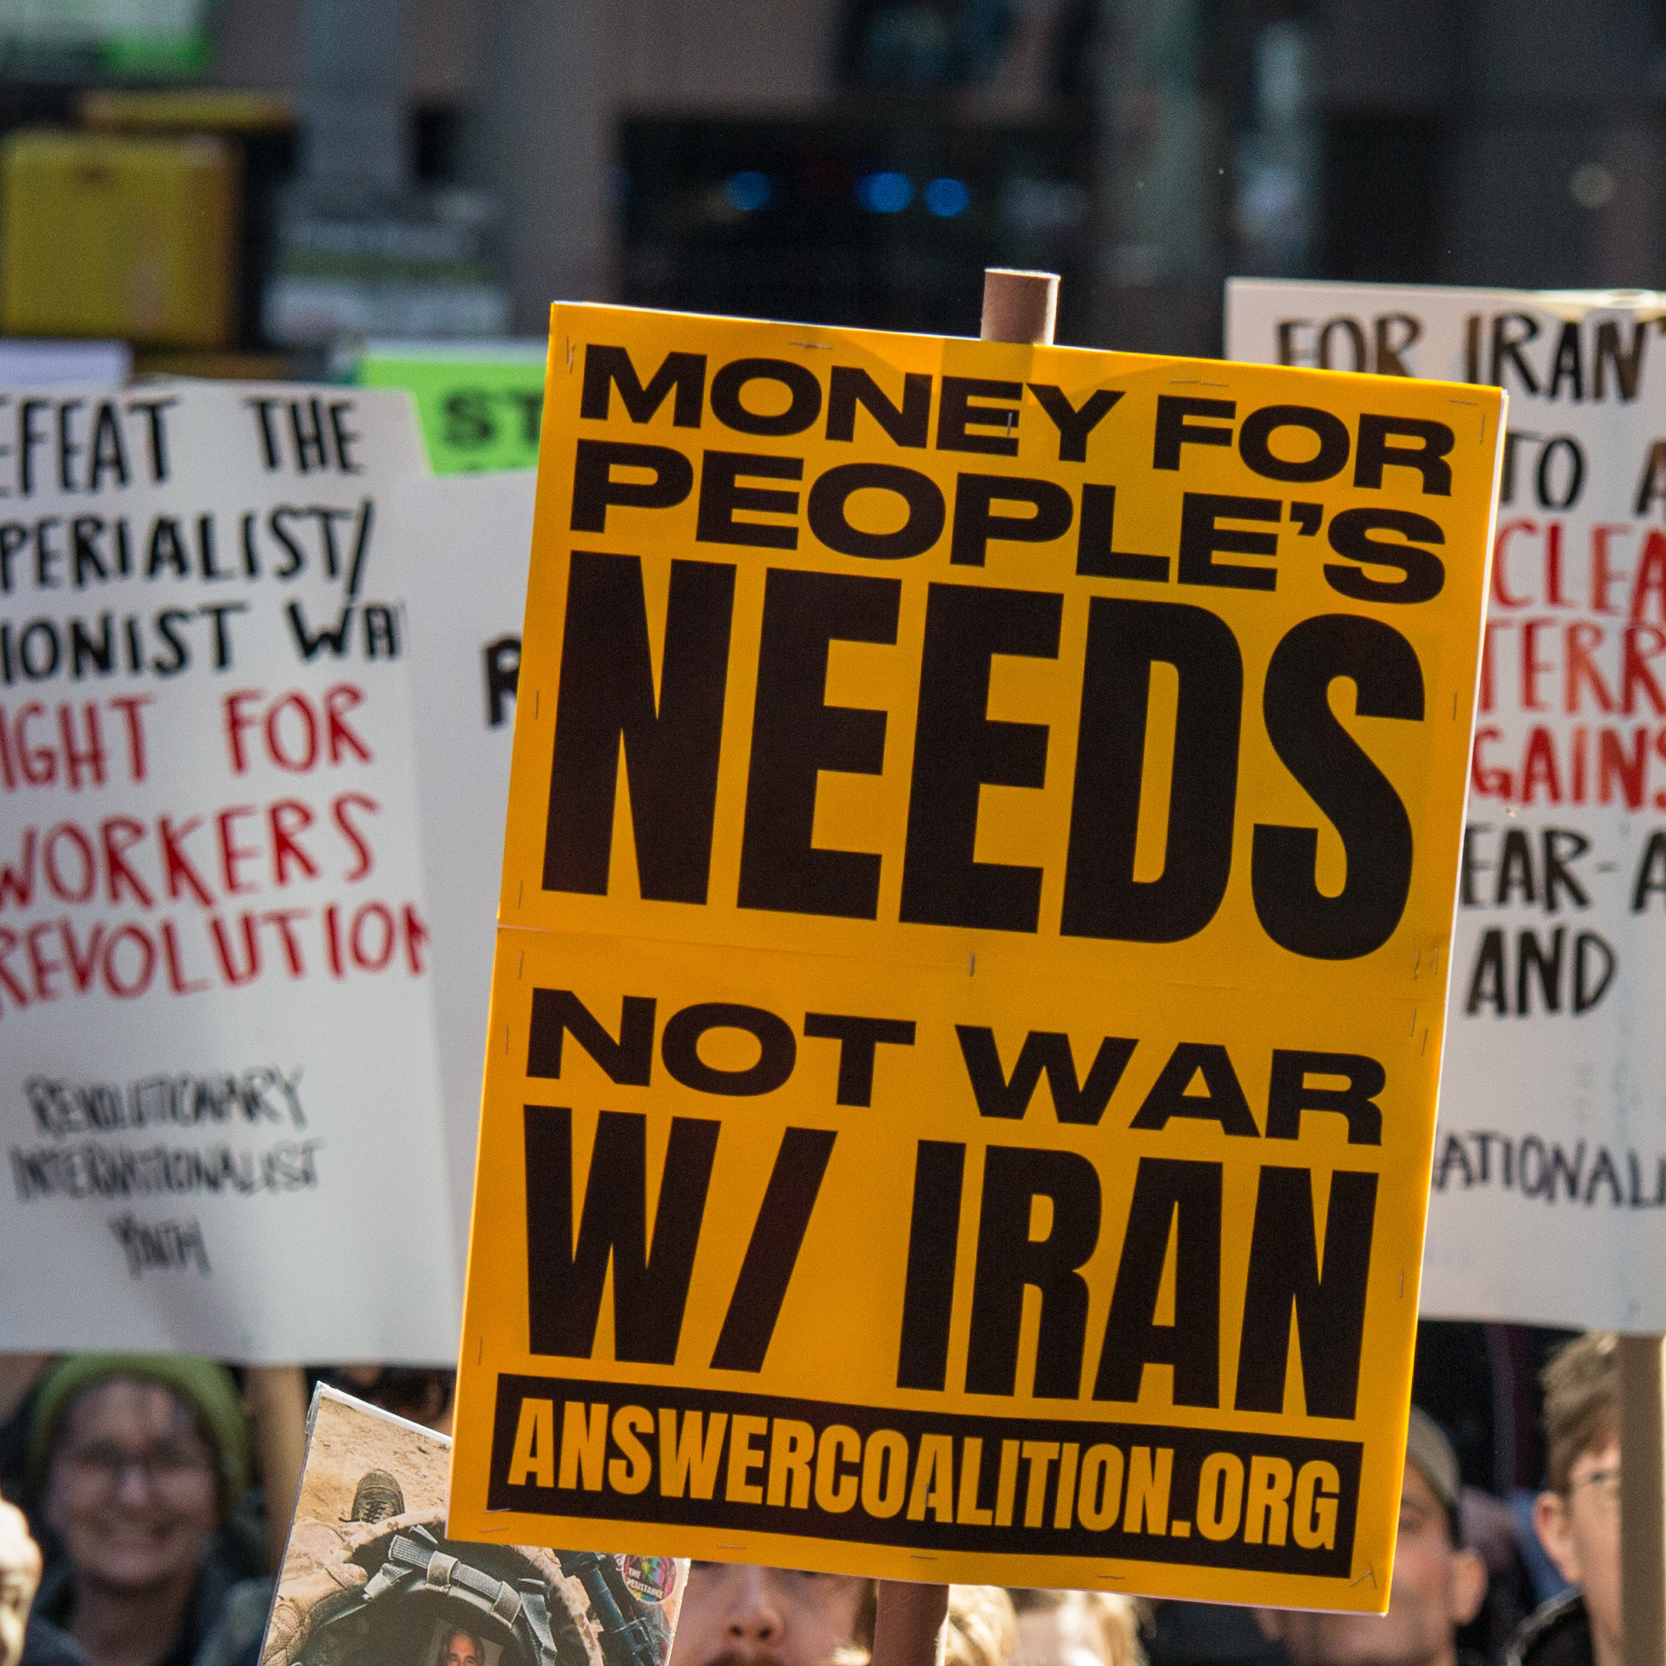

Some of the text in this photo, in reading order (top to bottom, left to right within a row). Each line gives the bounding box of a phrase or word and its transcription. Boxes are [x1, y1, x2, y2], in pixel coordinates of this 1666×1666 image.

[579, 343, 1455, 497] MONEY FOR
[1276, 314, 1424, 378] FOR
[242, 390, 364, 476] THE
[570, 438, 1447, 604] PEOPLE'S
[221, 681, 373, 778] FOR
[541, 549, 1426, 960] NEEDS
[1463, 924, 1619, 1019] AND
[526, 987, 1388, 1147] NOT WAR
[522, 1103, 1379, 1421] W/ IRAN
[507, 1397, 1341, 1551] ANSWERCOALITION.ORG
